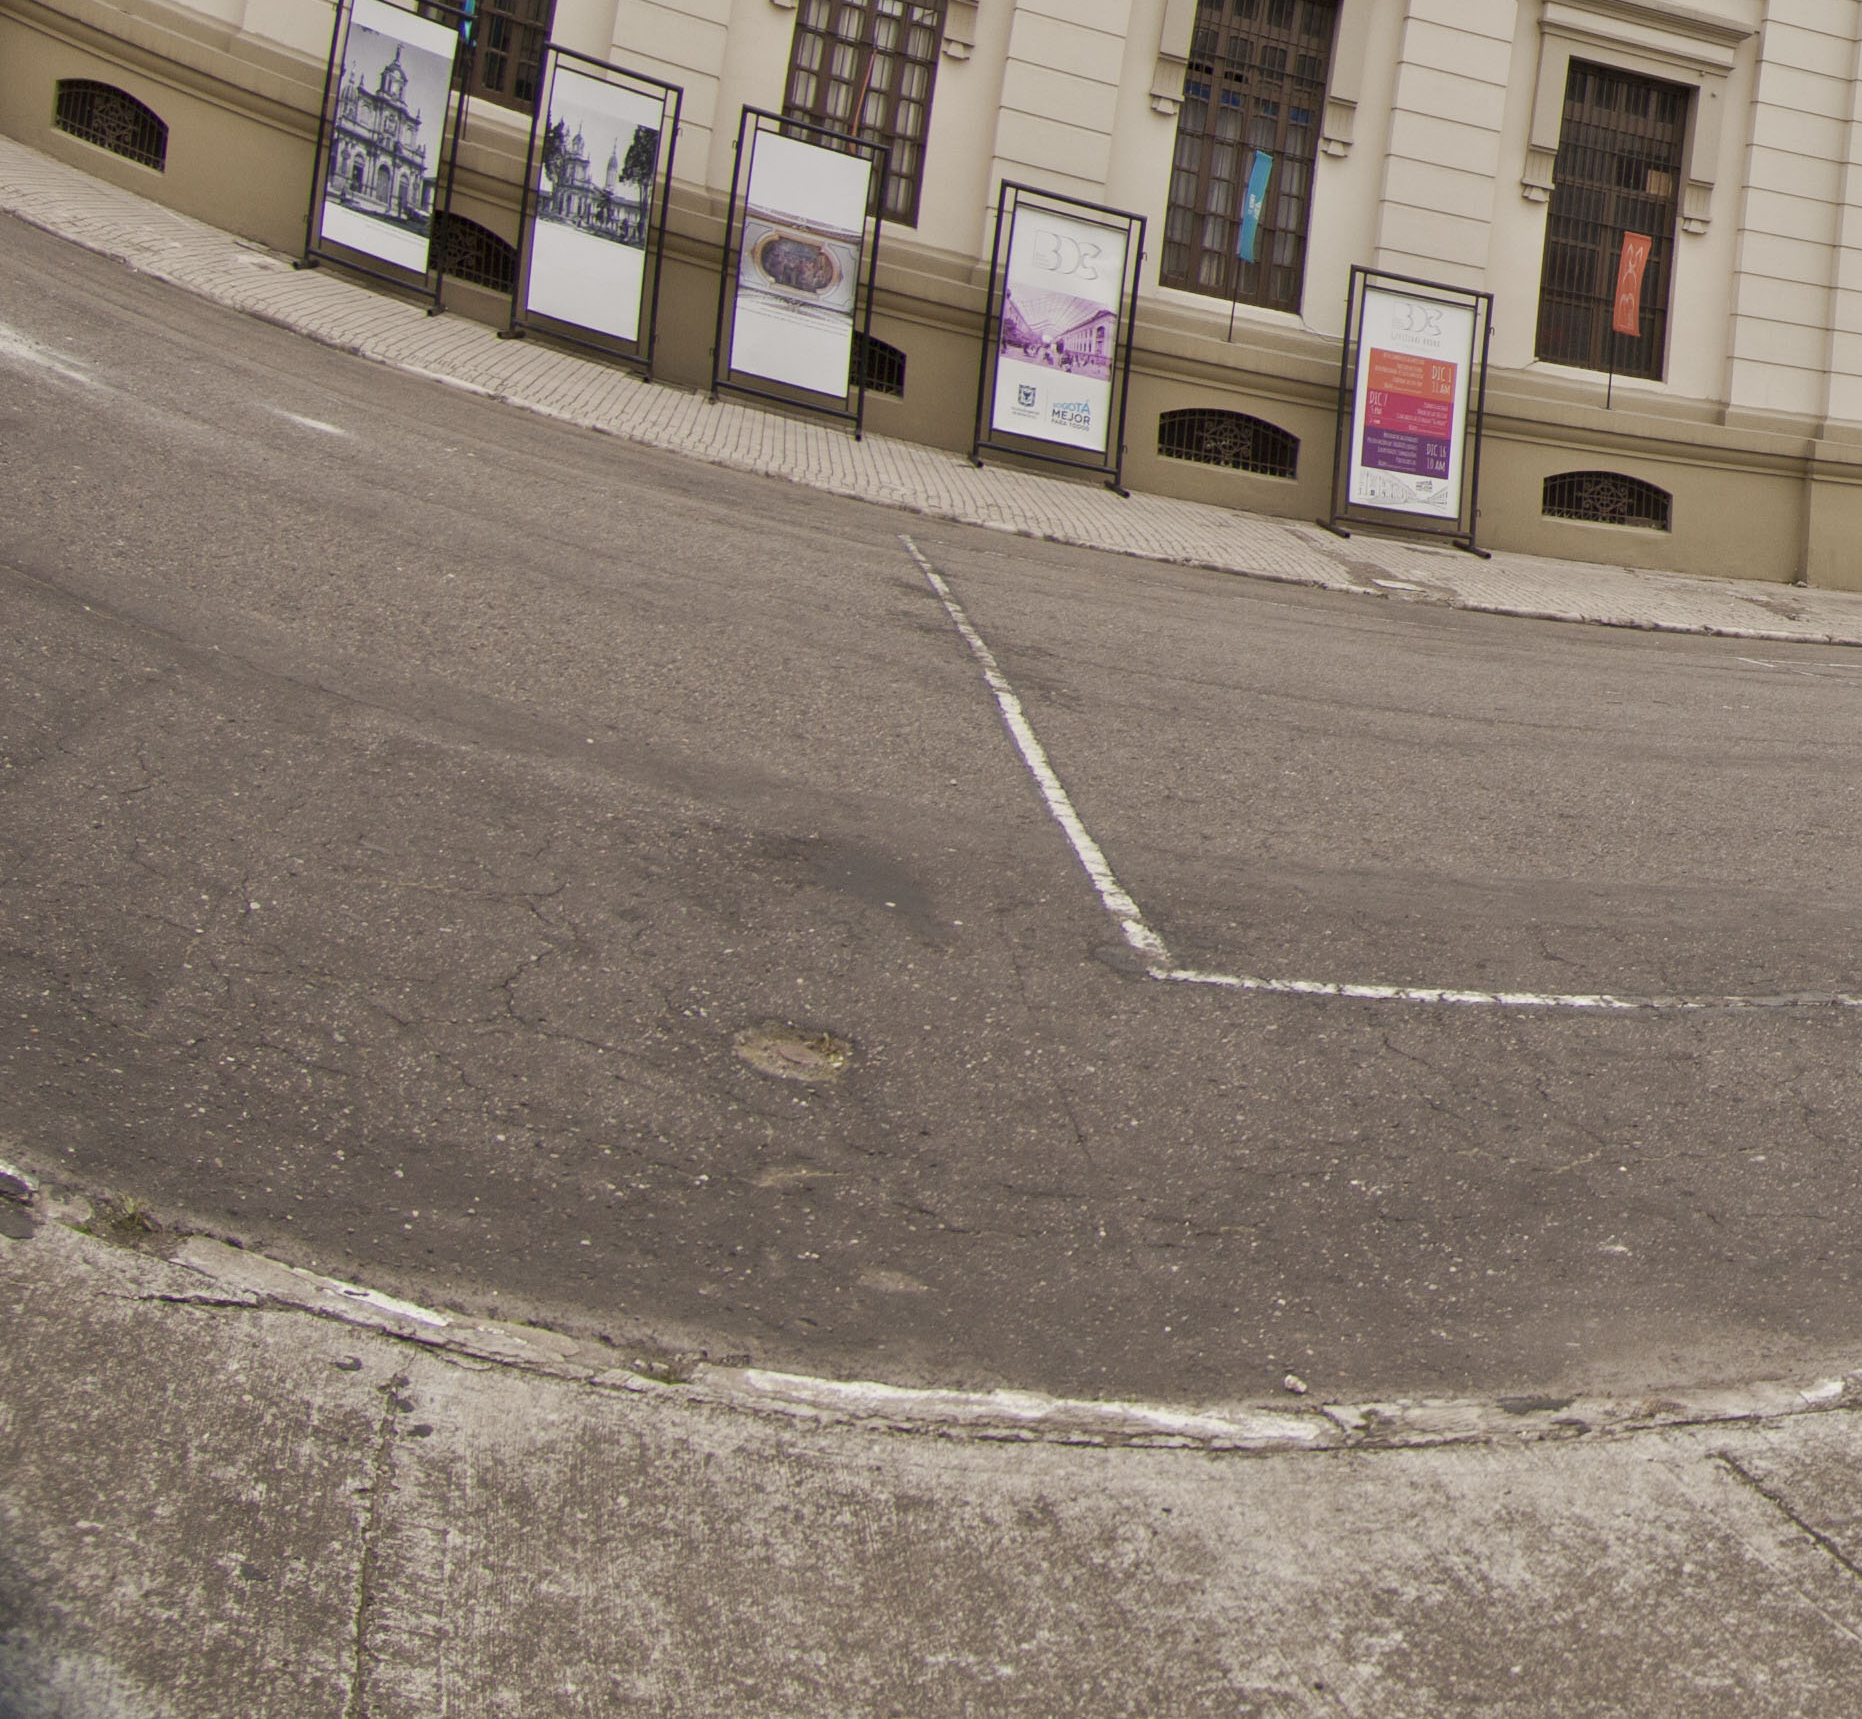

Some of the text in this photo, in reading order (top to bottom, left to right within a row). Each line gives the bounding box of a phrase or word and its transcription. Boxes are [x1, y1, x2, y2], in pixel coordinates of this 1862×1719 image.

[1431, 365, 1446, 381] DIC
[1439, 384, 1451, 394] AM
[1052, 398, 1091, 414] BOGOTÁ
[1369, 390, 1383, 406] DIC
[1051, 409, 1091, 425] MEJOR
[1426, 443, 1438, 456] DIC
[1434, 460, 1446, 472] AM
